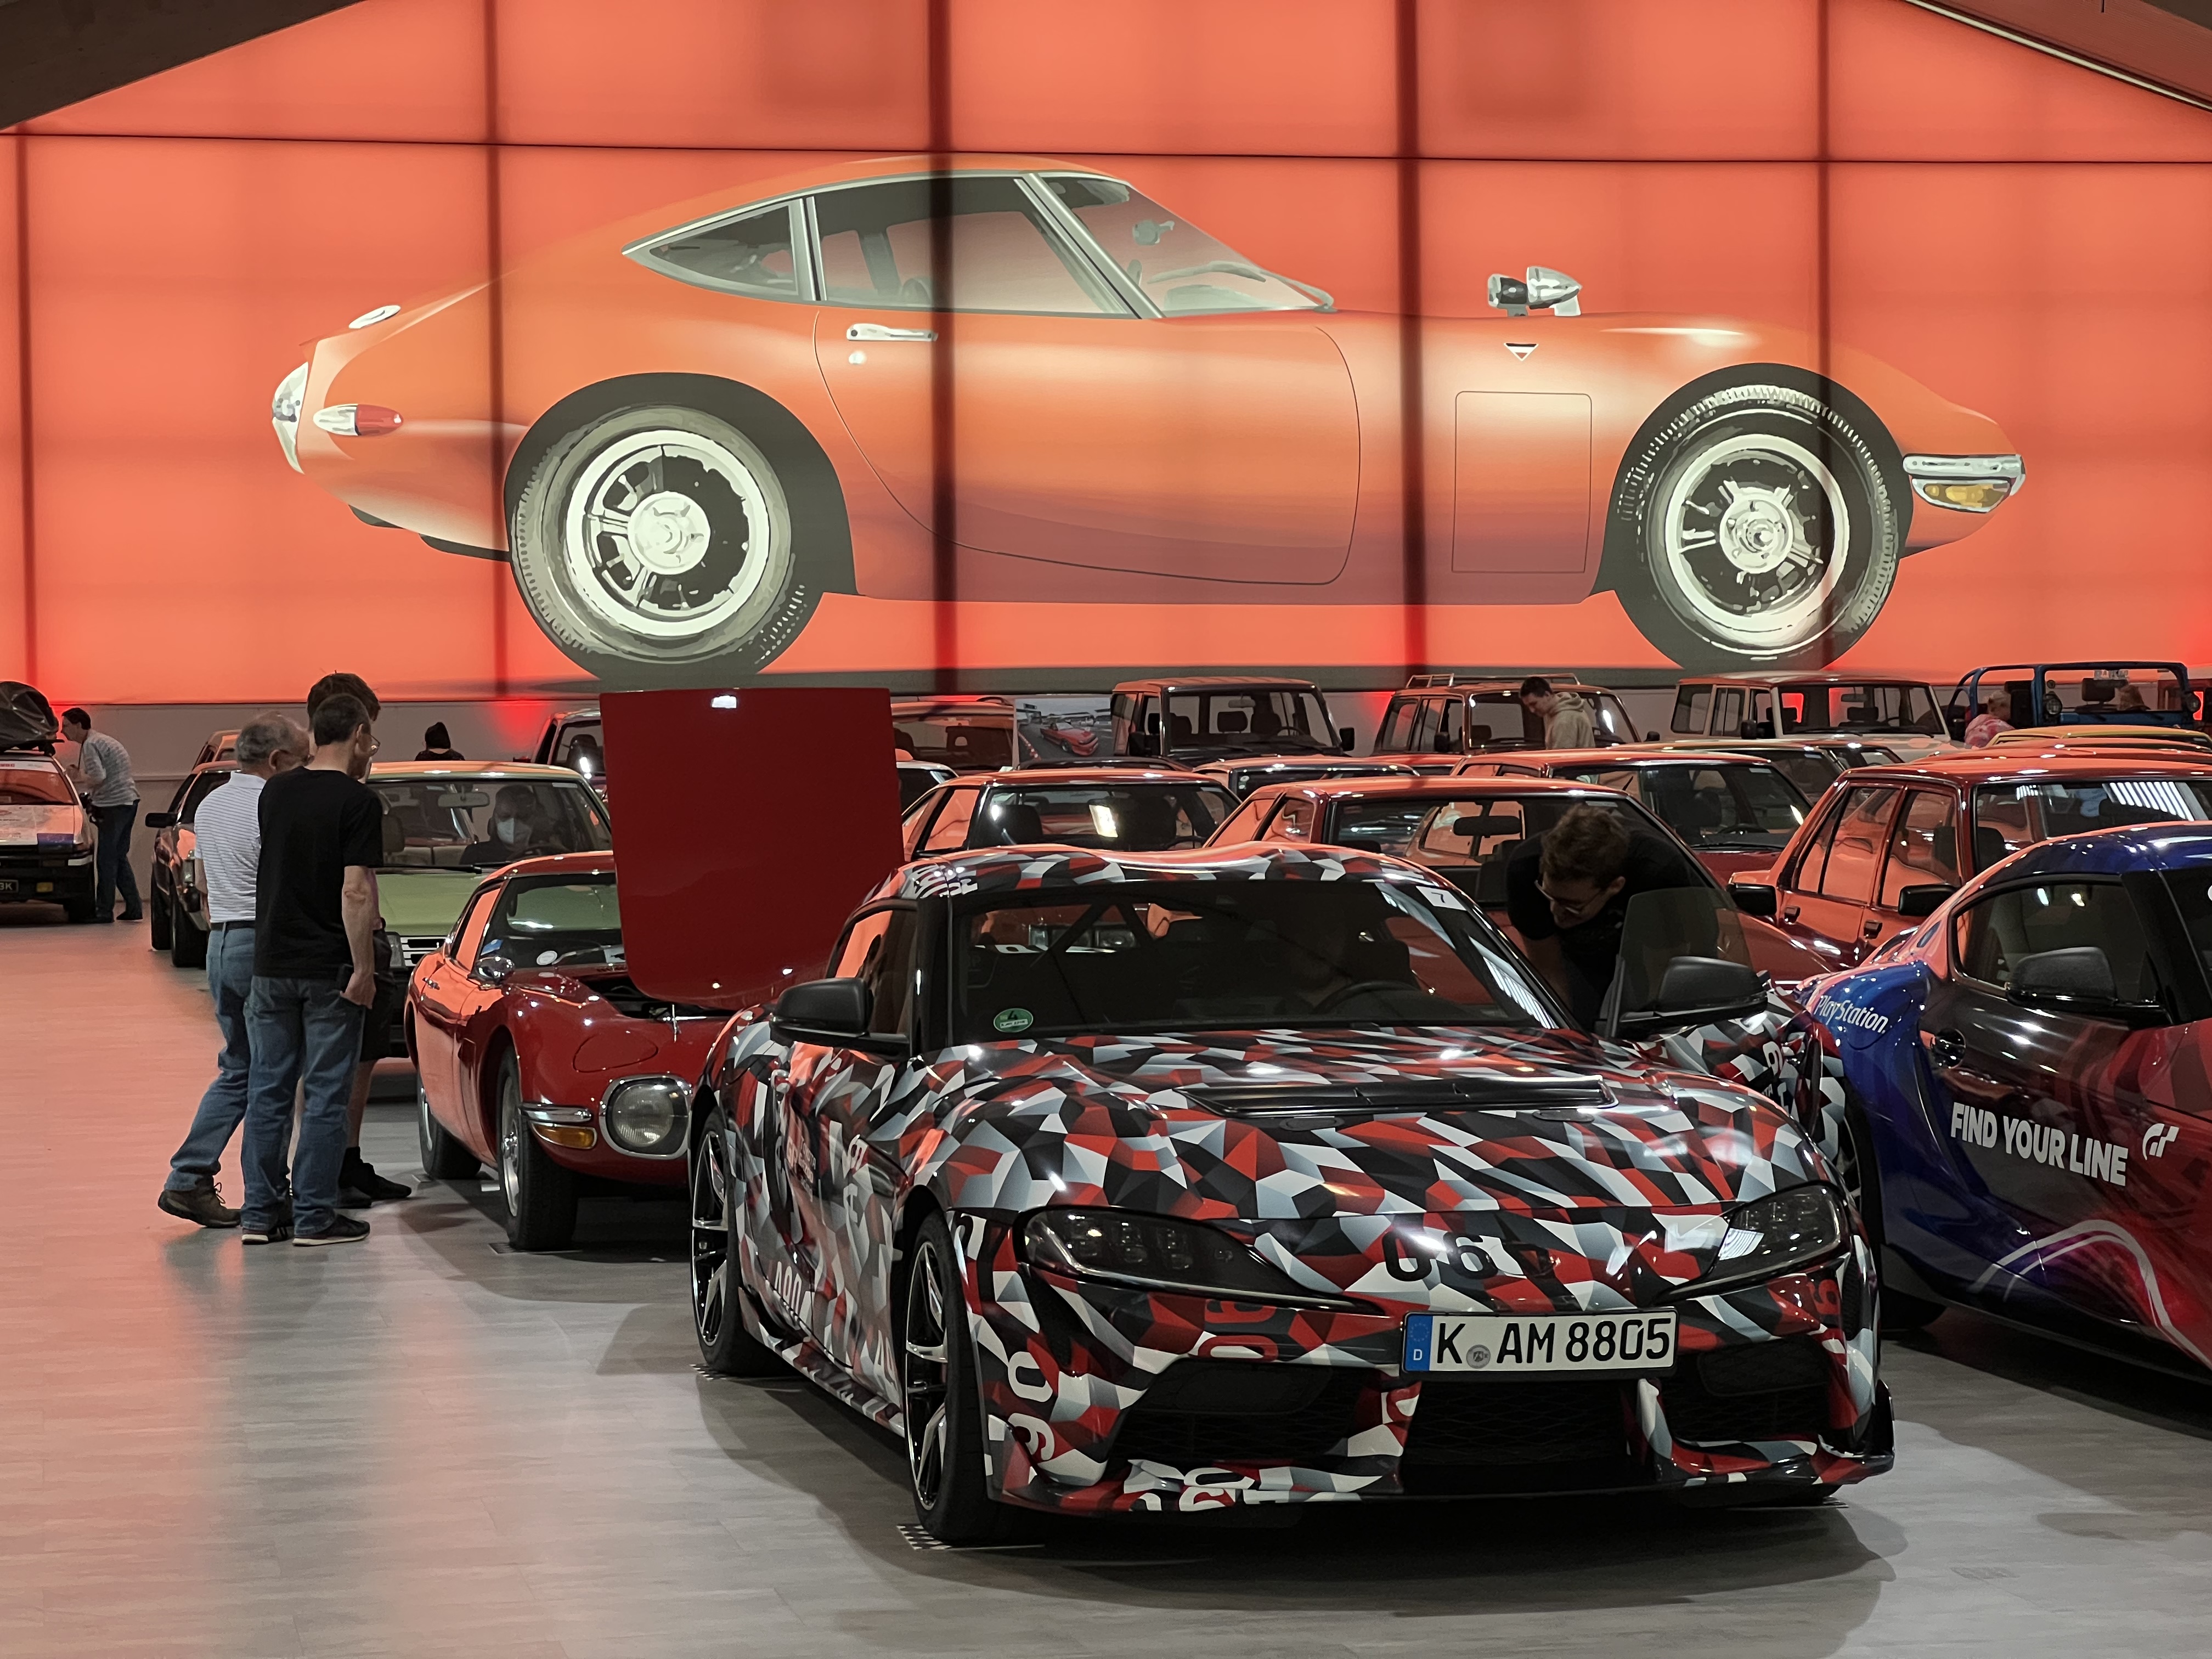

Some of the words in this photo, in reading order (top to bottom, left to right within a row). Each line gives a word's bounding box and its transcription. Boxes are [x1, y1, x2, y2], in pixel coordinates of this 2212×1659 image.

[1950, 1102, 1997, 1149] FIND
[2003, 1115, 2066, 1170] YOUR
[2069, 1133, 2129, 1186] LINE
[1413, 1348, 1423, 1361] D
[1437, 1322, 1466, 1364] K
[1496, 1322, 1556, 1364] AM
[1565, 1318, 1672, 1363] 8805
